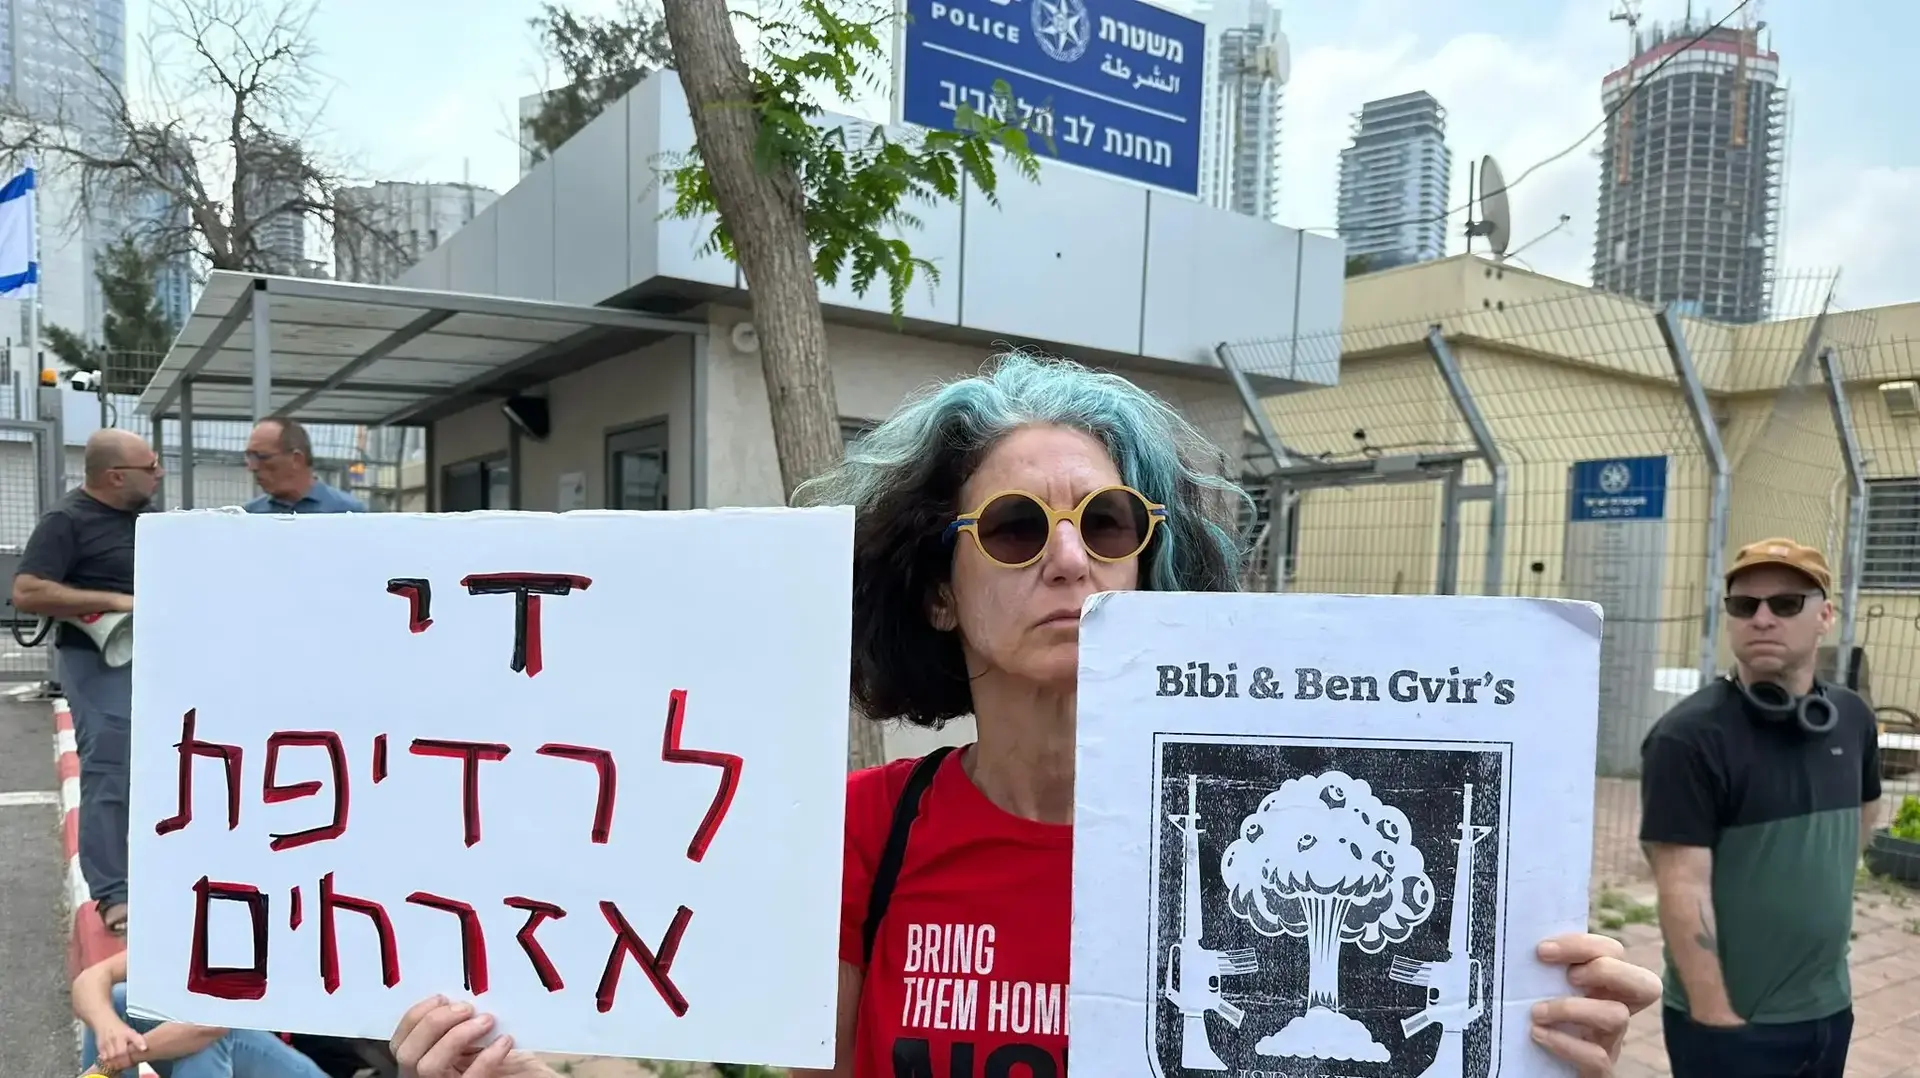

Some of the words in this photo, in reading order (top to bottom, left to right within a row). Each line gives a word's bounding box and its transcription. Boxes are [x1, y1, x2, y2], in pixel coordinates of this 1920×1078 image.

[931, 2, 1019, 43] POLICE
[1099, 15, 1183, 64] משטרת
[1101, 53, 1179, 93] الشرطة
[940, 80, 1006, 124] אביב
[1018, 98, 1054, 136] תל
[1063, 115, 1096, 147] לב
[1103, 127, 1172, 168] תחנת
[387, 572, 593, 678] די
[1156, 661, 1240, 699] Bibi
[1248, 666, 1284, 700] &
[1294, 668, 1381, 702] Ben
[156, 689, 744, 863] לרדיפת
[186, 871, 694, 1018] אזרחים
[903, 923, 996, 975] BRING
[902, 977, 979, 1031] THEM
[987, 980, 1069, 1035] HOM
